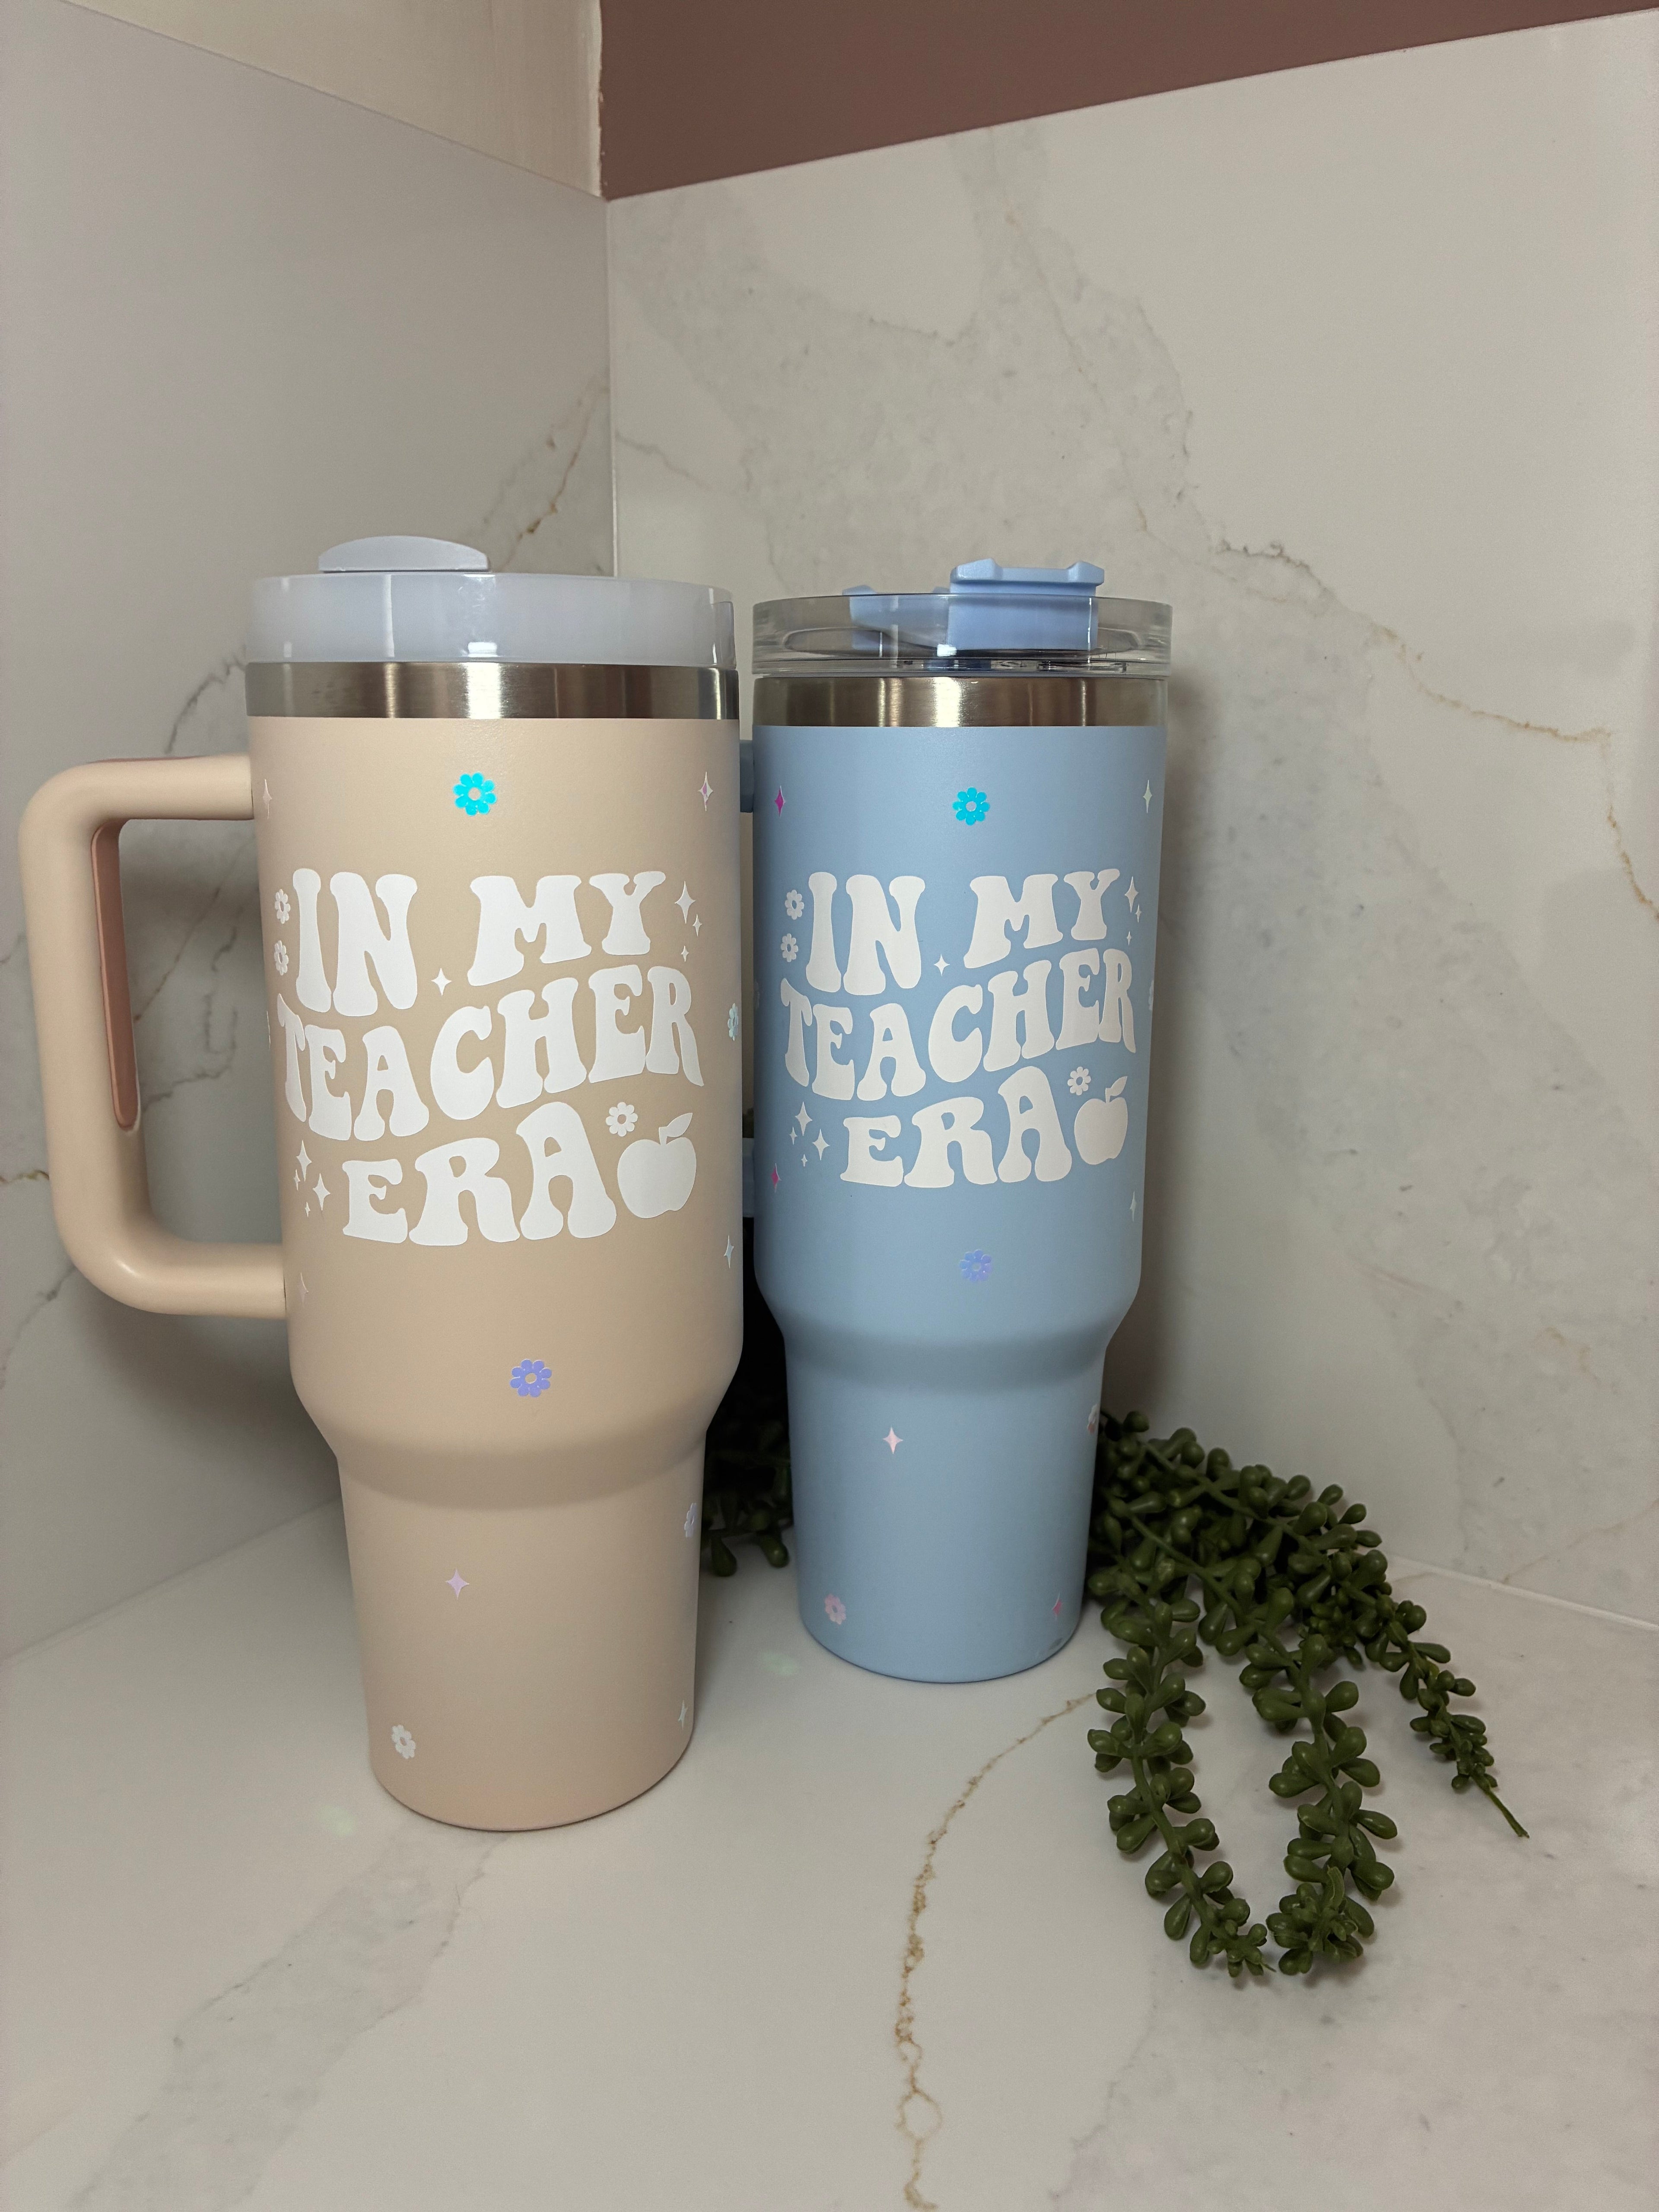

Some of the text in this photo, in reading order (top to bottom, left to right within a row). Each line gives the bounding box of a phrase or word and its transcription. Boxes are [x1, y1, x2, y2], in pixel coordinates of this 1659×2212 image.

[292, 868, 666, 1018] IN MY
[805, 868, 1120, 996] IN MY
[277, 964, 704, 1142] TEACHER
[780, 947, 1137, 1101] TEACHER
[341, 1102, 617, 1247] ERA
[840, 1065, 1073, 1189] ERA
